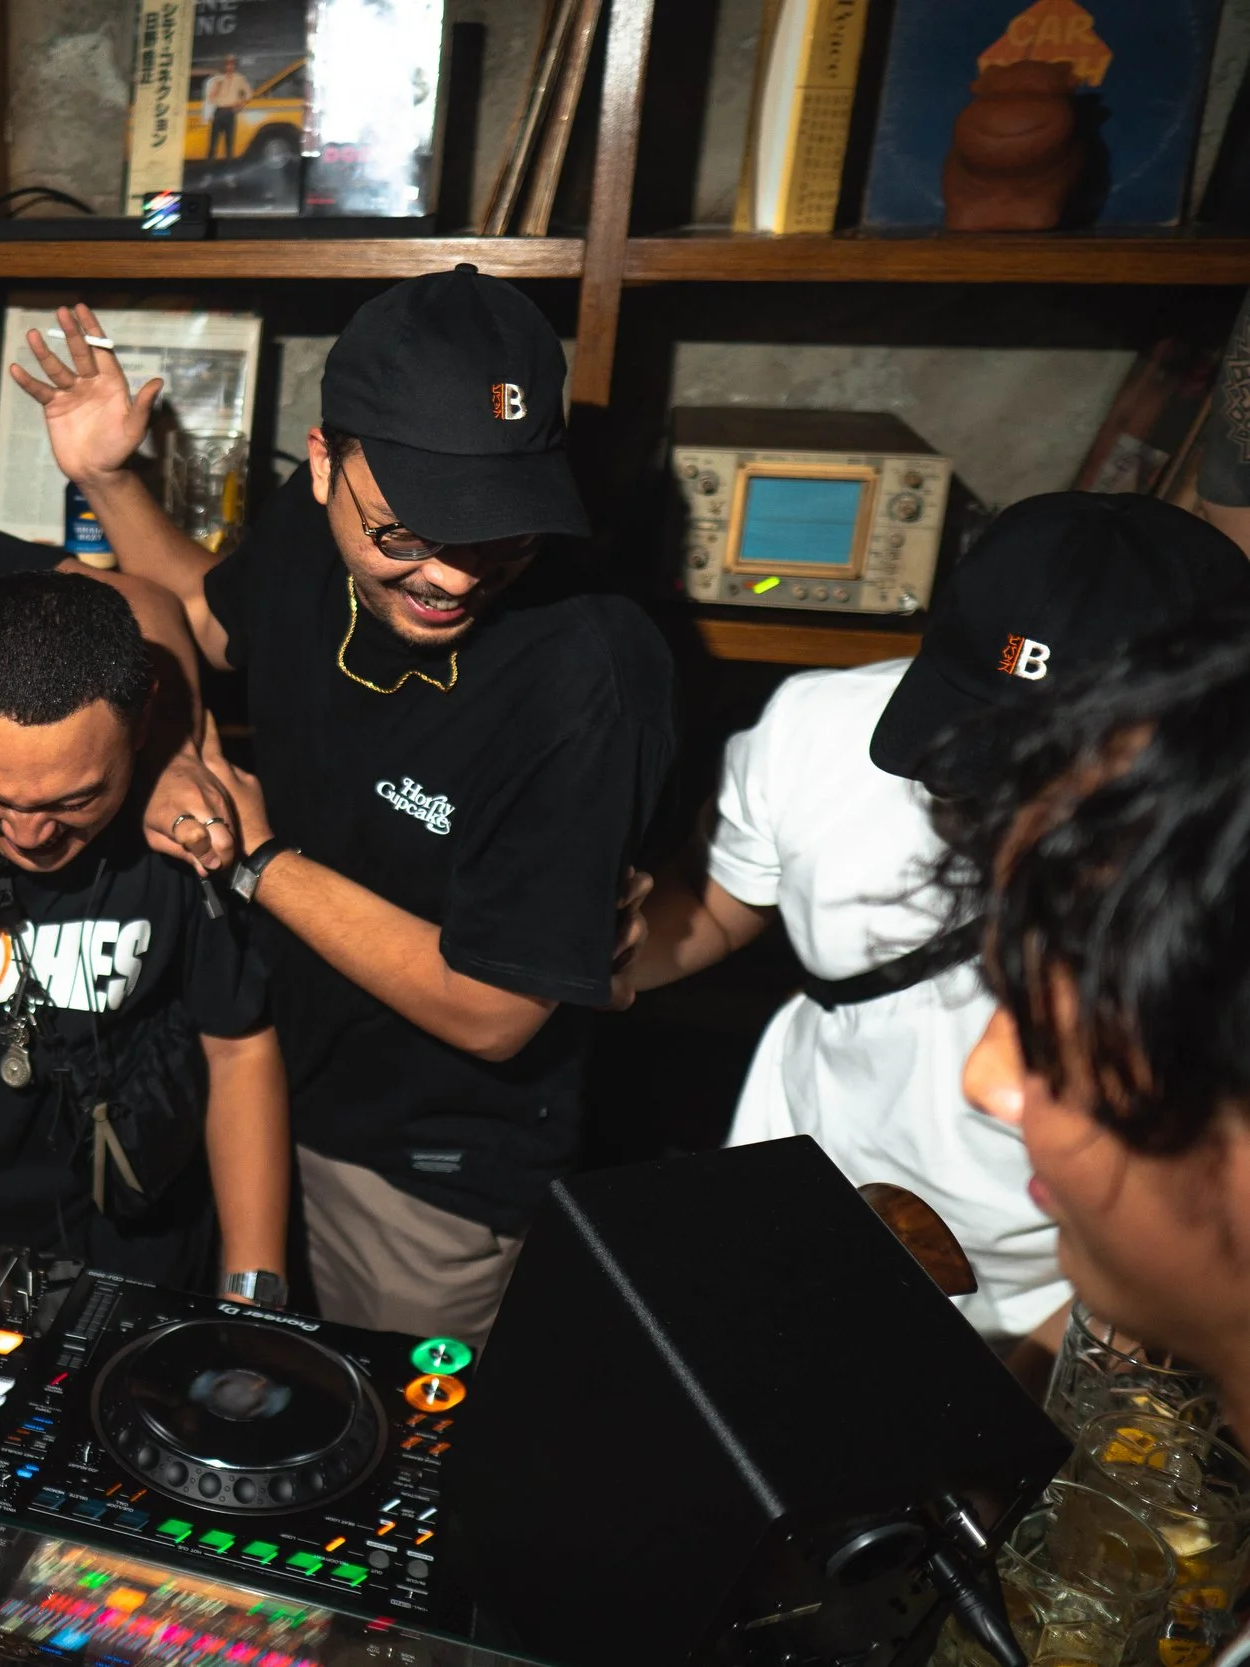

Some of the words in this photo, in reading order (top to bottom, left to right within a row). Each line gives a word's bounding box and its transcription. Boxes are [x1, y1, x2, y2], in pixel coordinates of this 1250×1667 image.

[1007, 13, 1097, 47] CAR
[504, 383, 528, 421] B
[1013, 638, 1051, 681] B
[401, 776, 456, 817] Horny
[217, 1303, 239, 1316] DJ
[243, 1307, 321, 1332] Pioneer
[279, 1532, 296, 1541] LOOP
[177, 1544, 191, 1552] CUE
[191, 1547, 202, 1555] HOT
[370, 1568, 383, 1576] OUT
